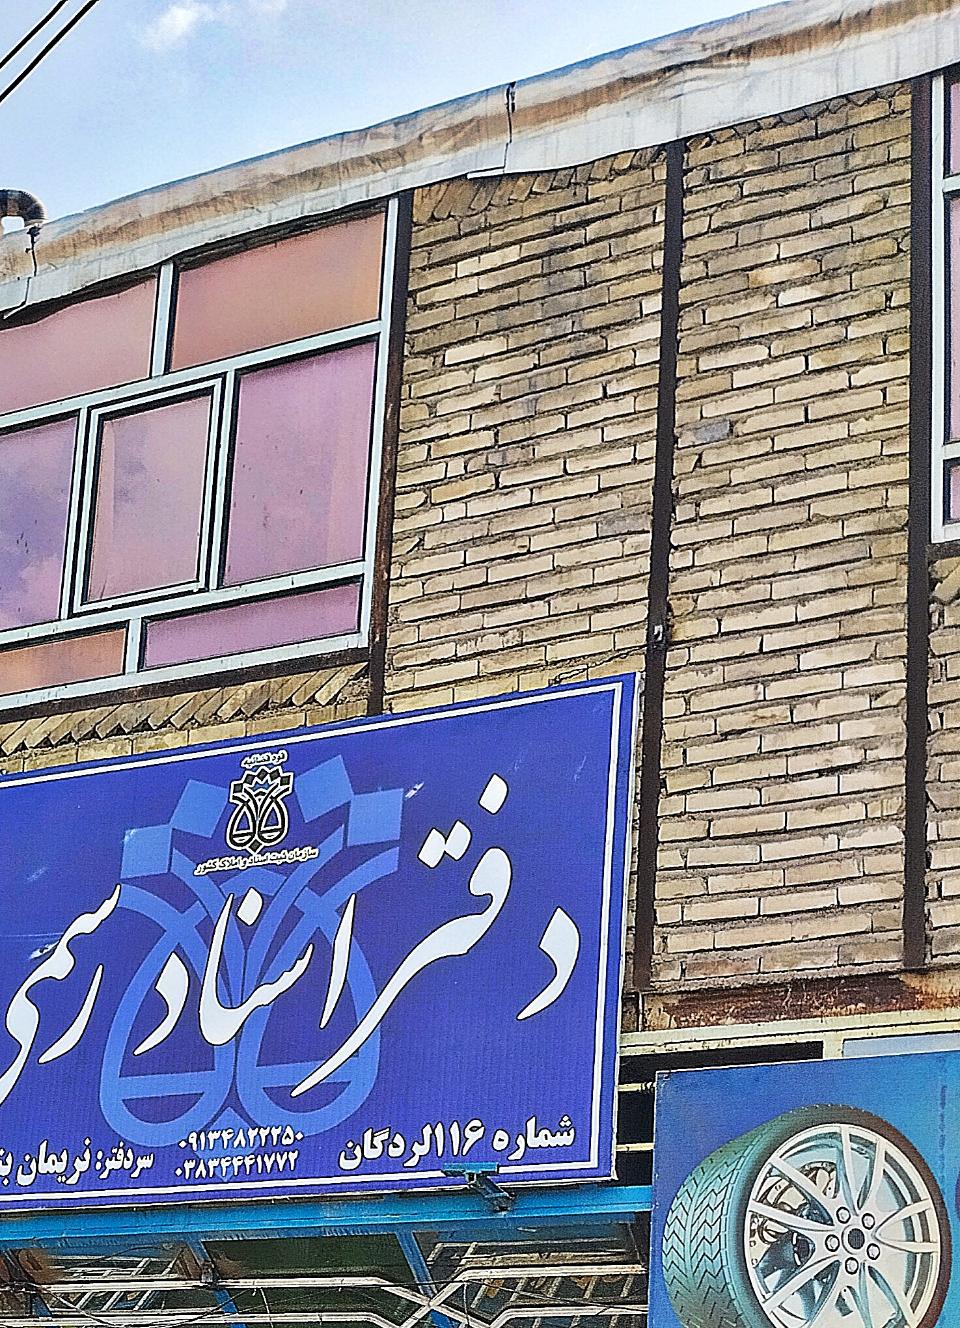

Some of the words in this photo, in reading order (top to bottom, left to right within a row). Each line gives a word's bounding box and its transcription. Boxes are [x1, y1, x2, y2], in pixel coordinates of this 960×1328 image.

[291, 773, 582, 1098] دفتر
[135, 887, 356, 1057] اسناد
[96, 1140, 154, 1179] سردفتر:
[179, 1125, 304, 1151] ۰۹۱۳۴۸۲۲۲۵۰
[339, 1124, 434, 1170] لردگان
[492, 1115, 576, 1160] شماره
[16, 1137, 91, 1186] نریمان
[175, 1150, 299, 1179] ۰۳۸۳۴۴۴۱۷۷۲
